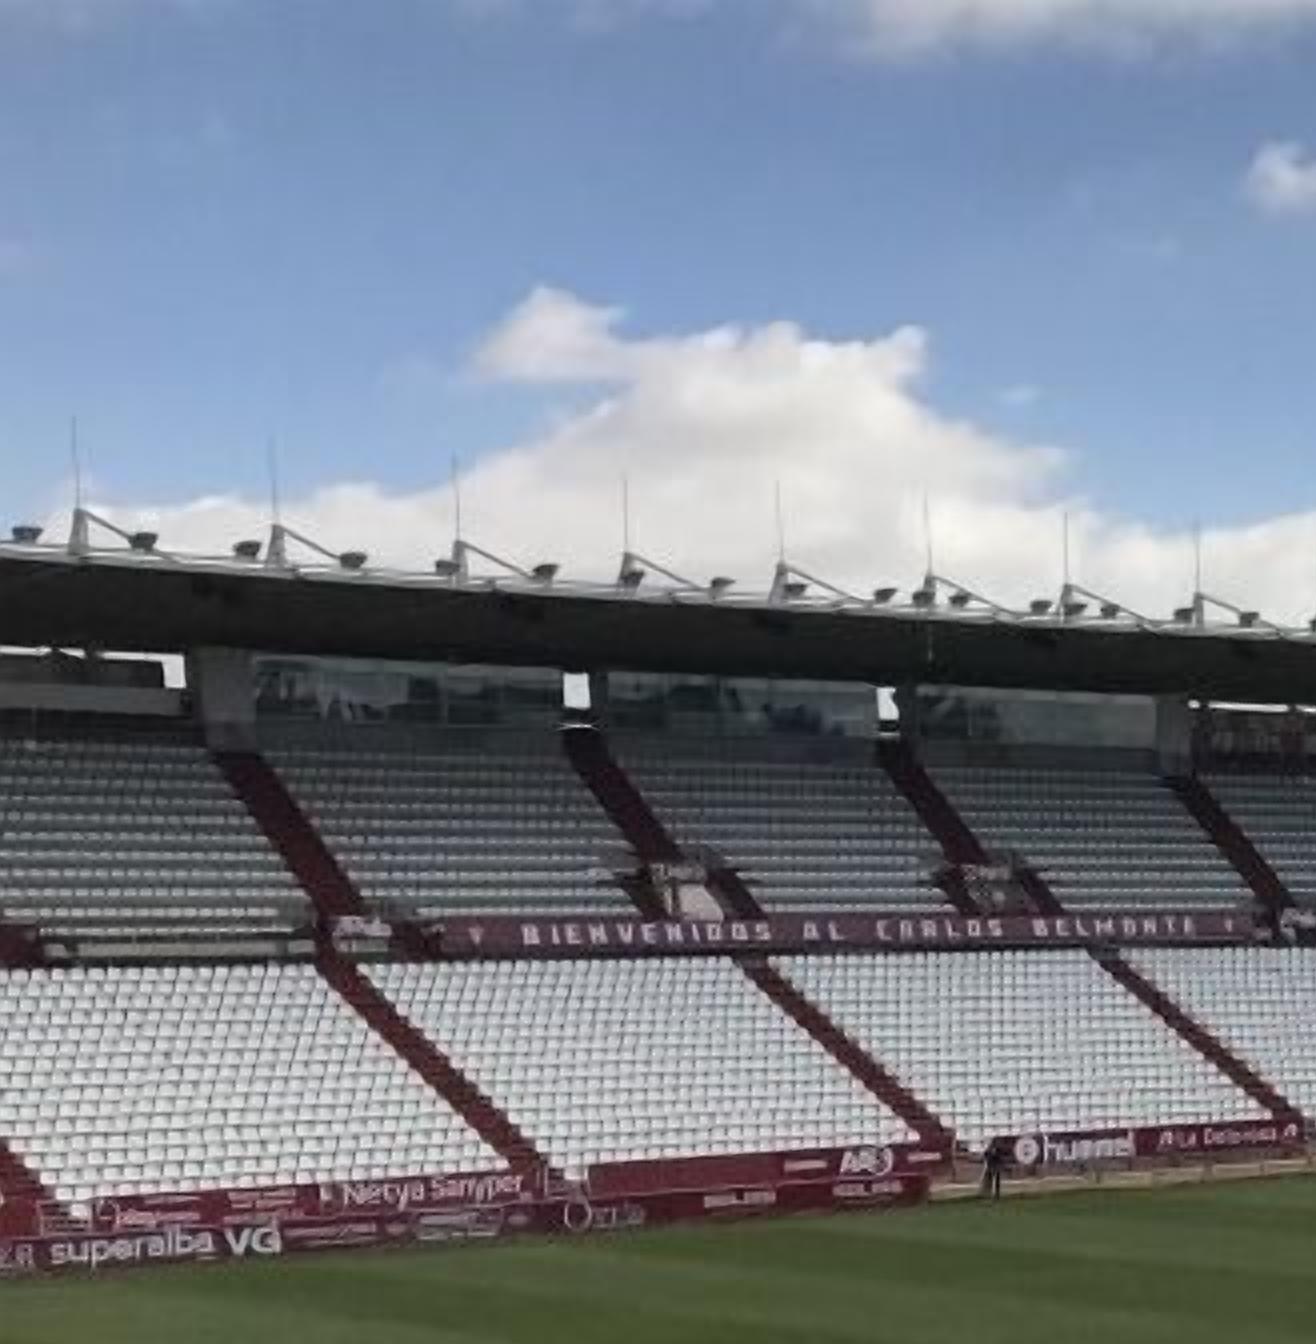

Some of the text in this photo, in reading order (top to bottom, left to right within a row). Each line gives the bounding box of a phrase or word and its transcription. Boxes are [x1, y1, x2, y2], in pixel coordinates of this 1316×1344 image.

[520, 914, 1195, 946] BIENVENIDOS AL CARLOS BELMONTE
[50, 1224, 216, 1269] superalba
